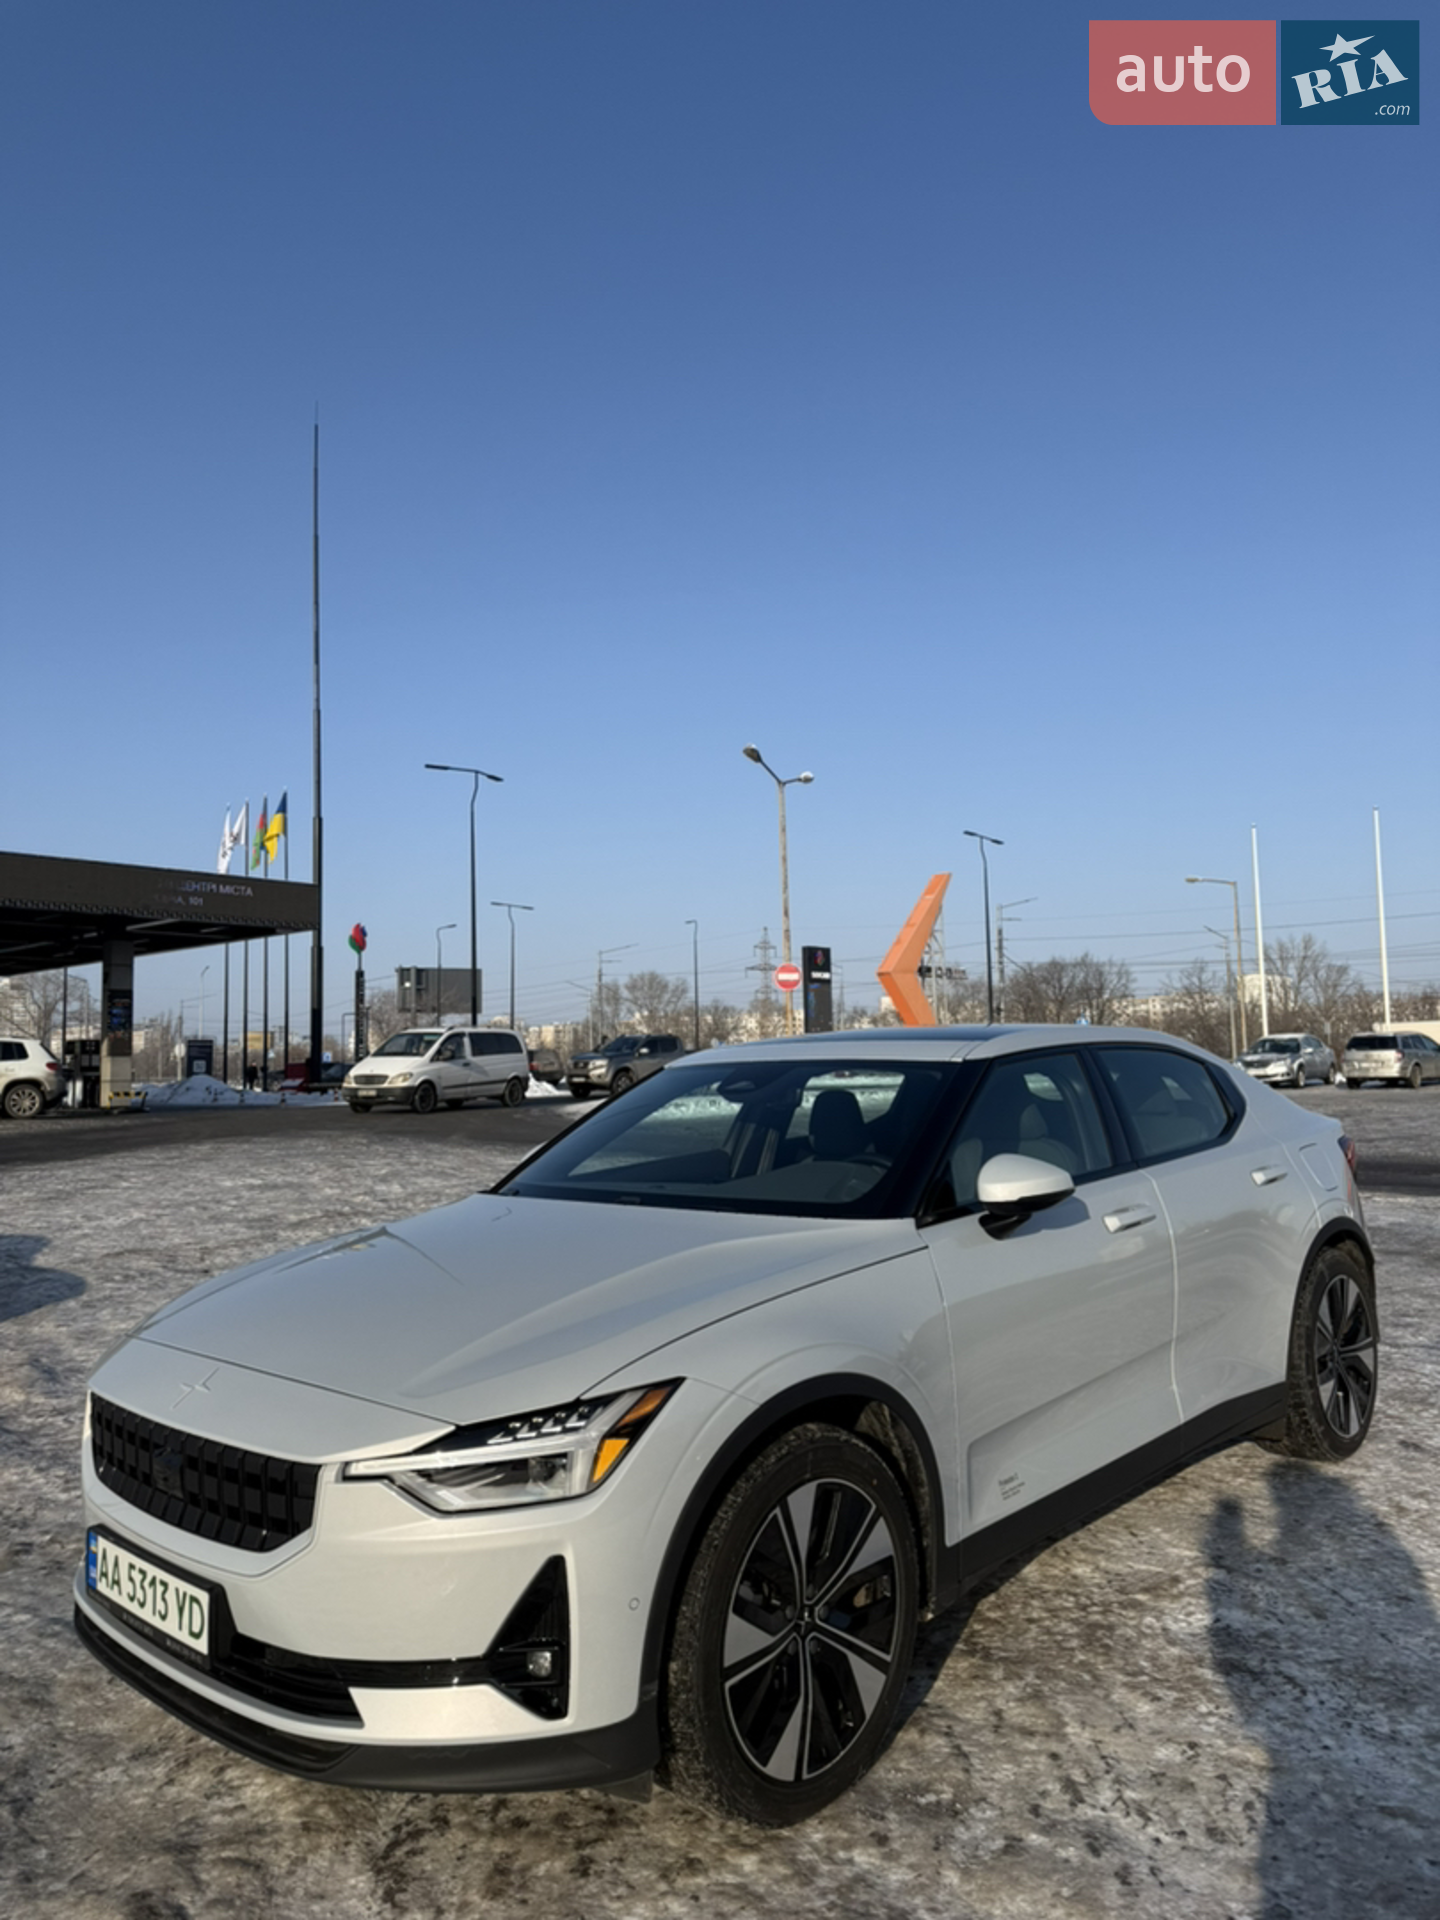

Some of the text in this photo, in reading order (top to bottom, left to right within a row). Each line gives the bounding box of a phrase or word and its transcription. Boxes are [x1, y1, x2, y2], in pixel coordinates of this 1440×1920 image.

[99, 1547, 123, 1597] AA
[127, 1561, 169, 1622] 5313
[174, 1586, 205, 1641] YD
